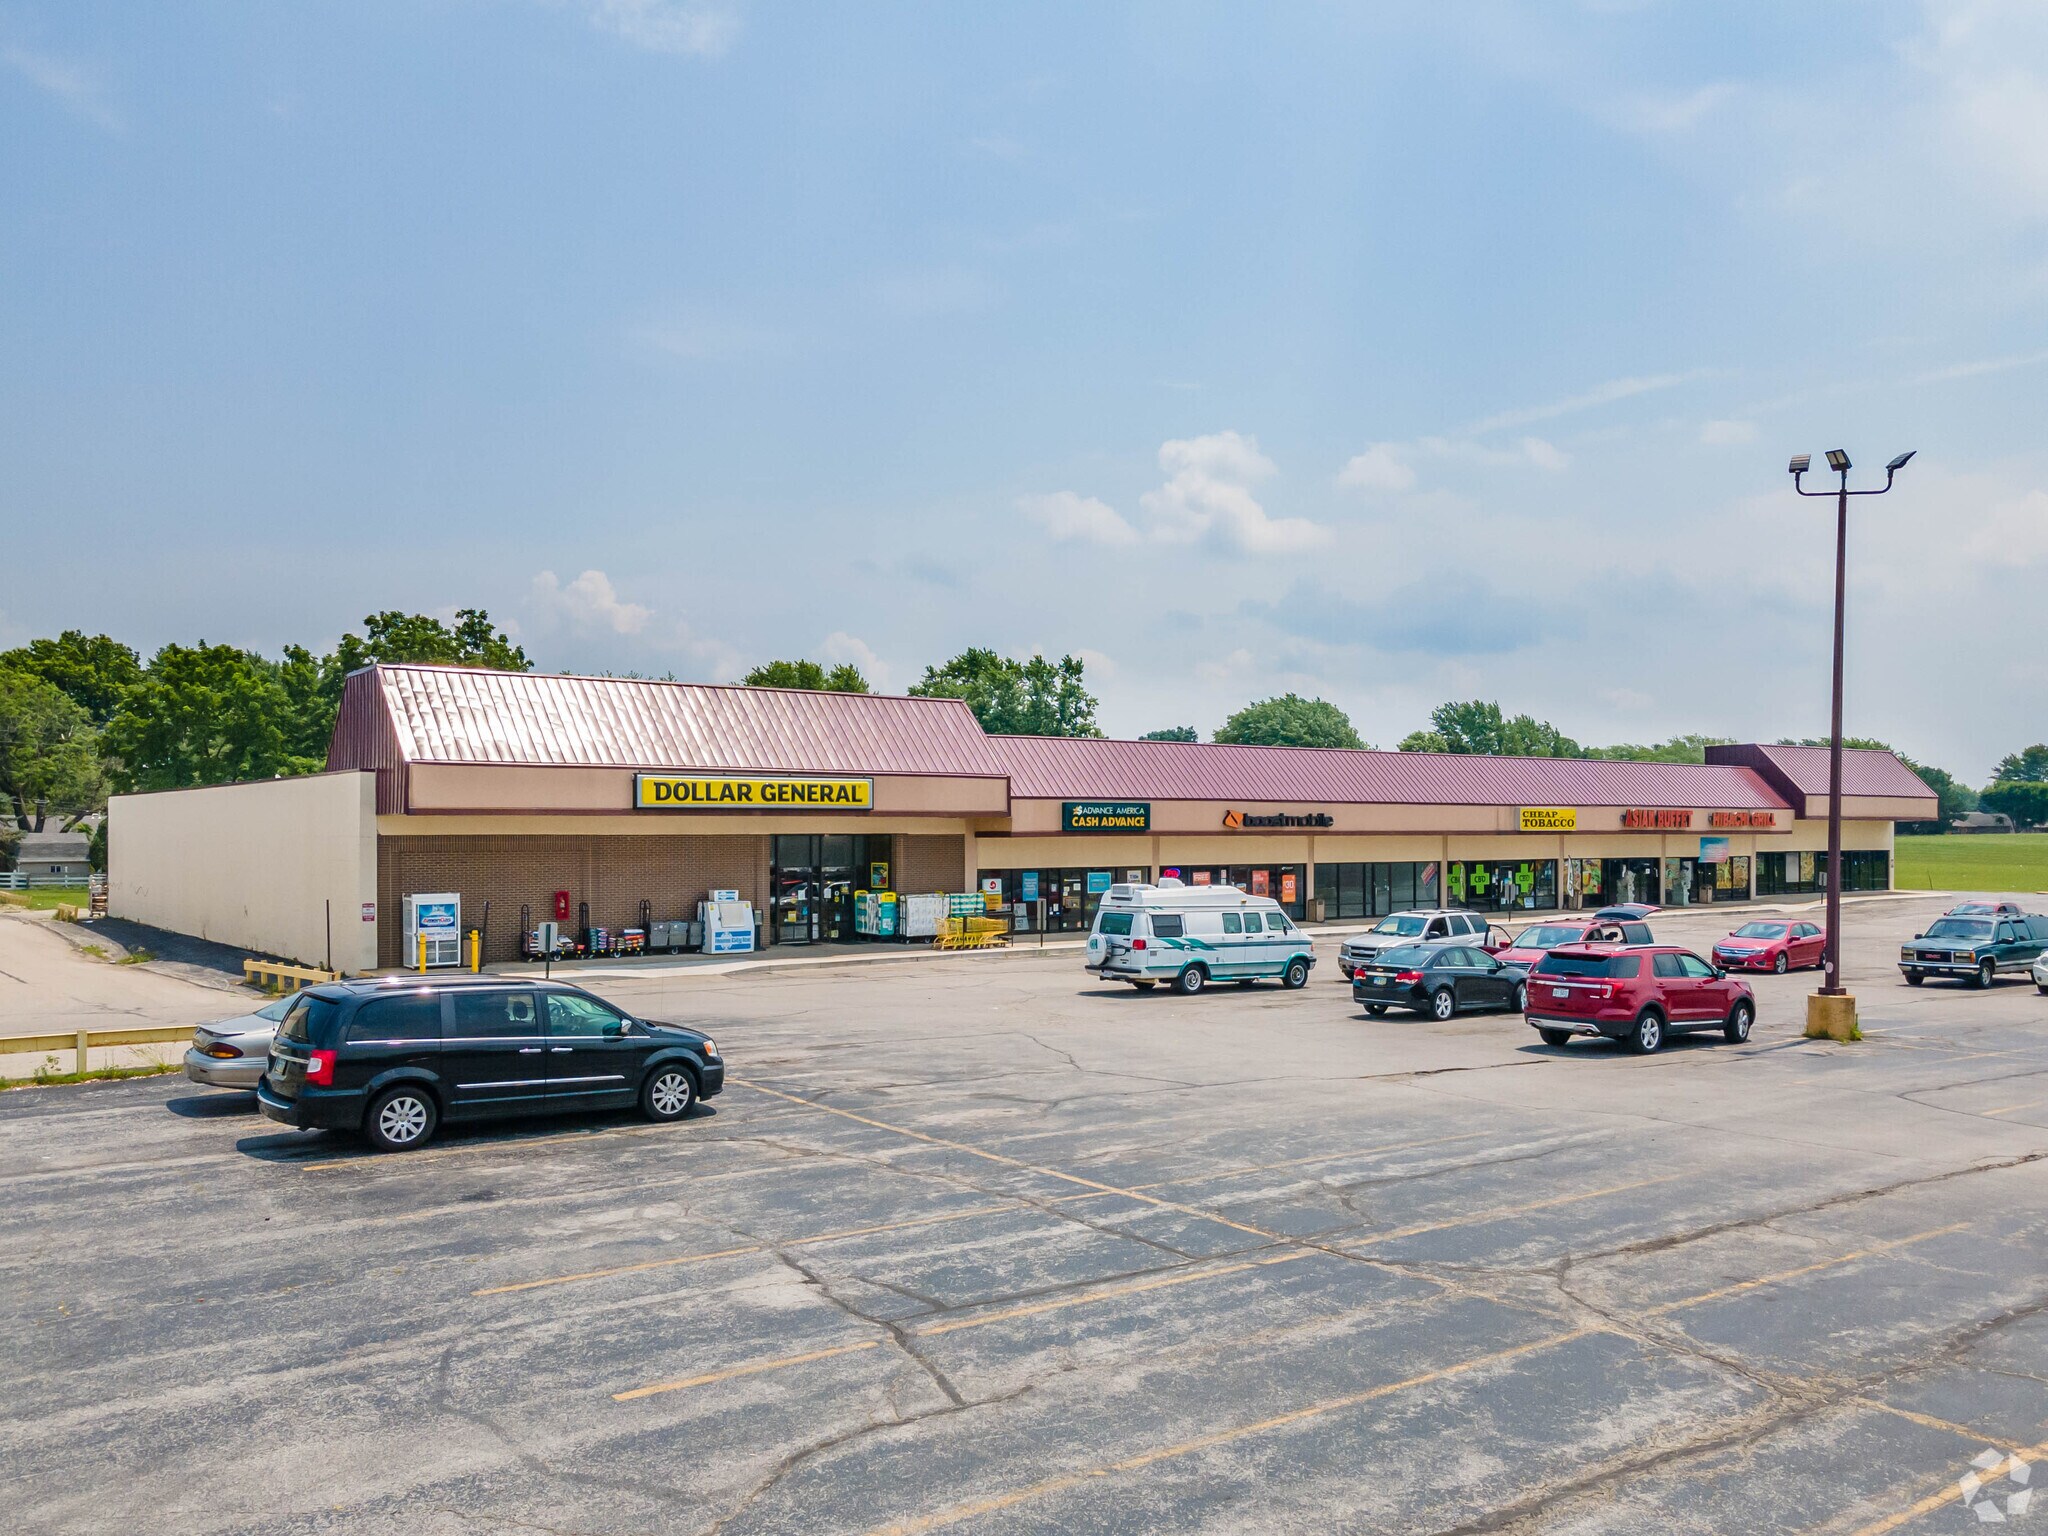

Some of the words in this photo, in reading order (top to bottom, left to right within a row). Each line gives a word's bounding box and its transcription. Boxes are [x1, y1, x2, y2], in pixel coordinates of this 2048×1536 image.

[653, 781, 753, 802] DOLLAR
[760, 782, 863, 803] GENERAL
[1083, 806, 1113, 815] ADVANCE
[1116, 806, 1145, 815] AMERICA
[1072, 816, 1099, 827] CASH
[1101, 816, 1145, 827] ADVANCE
[1522, 818, 1575, 828] TOBACCO
[1624, 808, 1656, 828] ASIAN
[1656, 809, 1693, 828] BUFFET
[1711, 811, 1749, 827] HIBACHI
[1750, 811, 1777, 827] GRILL
[1474, 875, 1486, 883] CBD
